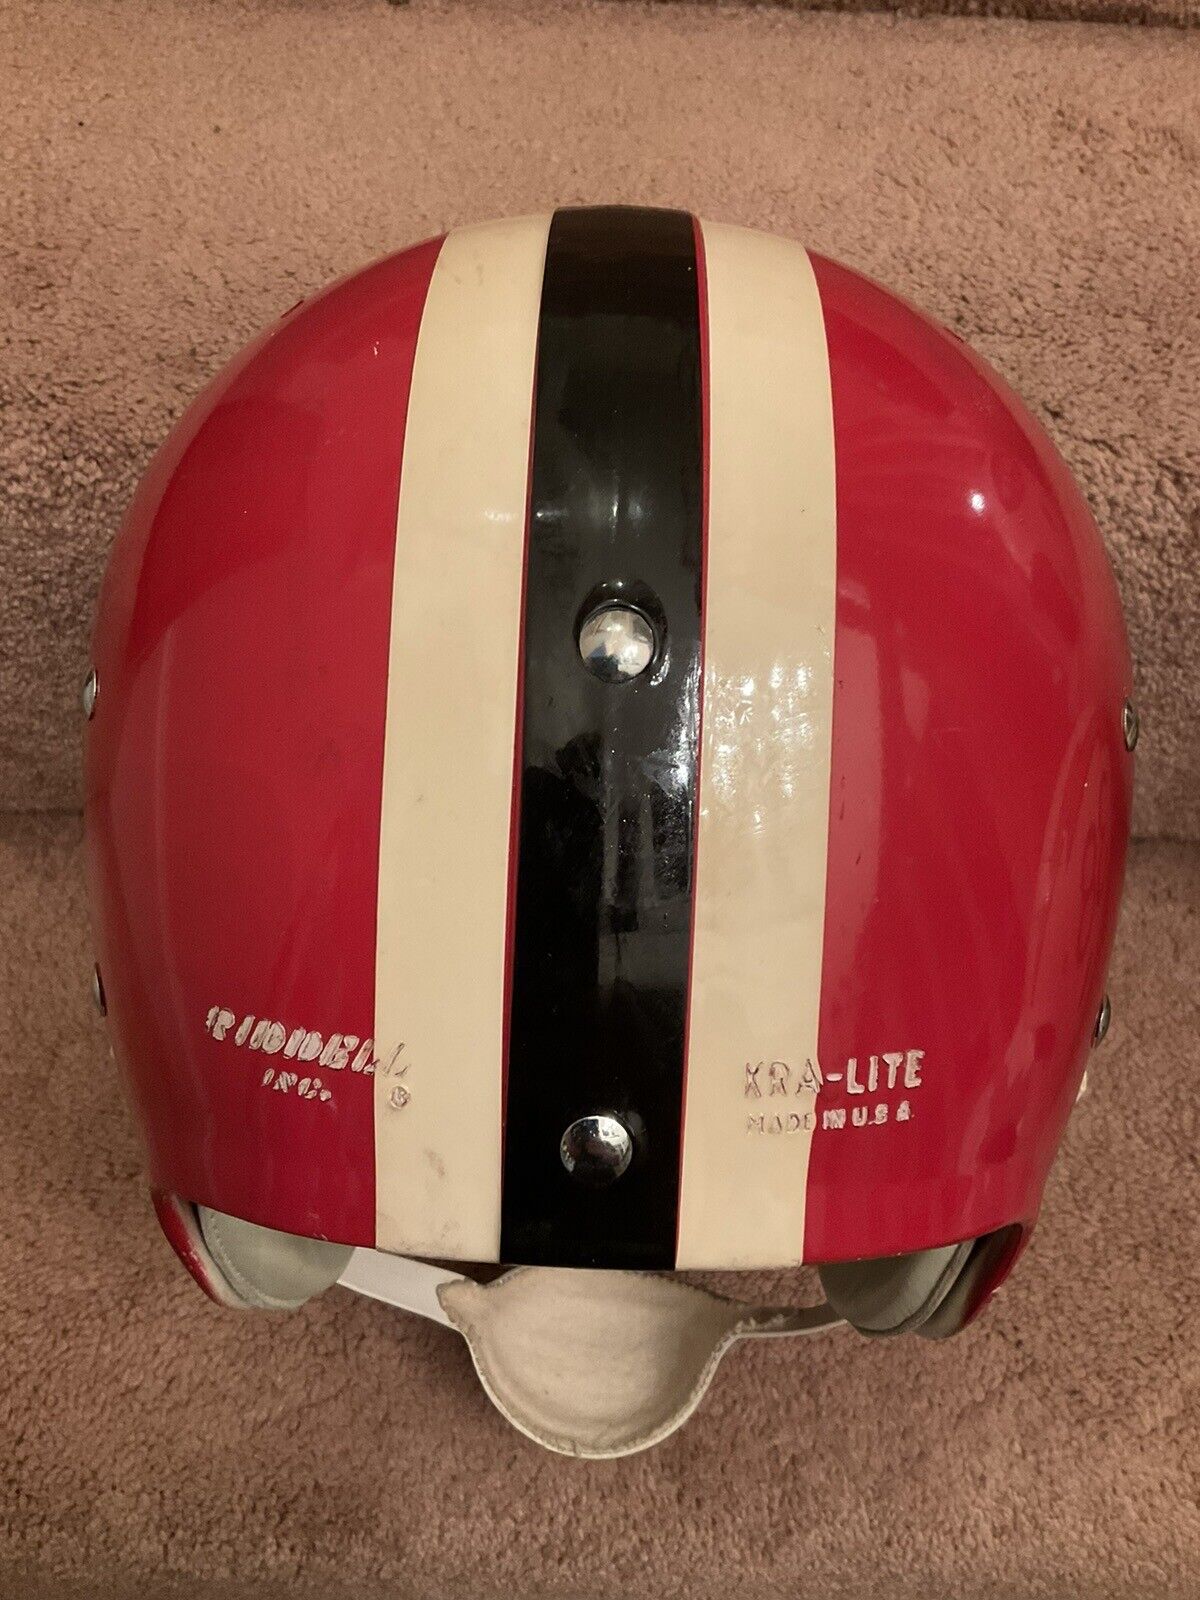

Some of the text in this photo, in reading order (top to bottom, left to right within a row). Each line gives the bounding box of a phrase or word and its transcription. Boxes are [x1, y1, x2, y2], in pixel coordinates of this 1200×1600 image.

[206, 1005, 411, 1077] RIDDELL
[744, 1050, 925, 1099] KRA-LITE
[747, 1111, 814, 1135] MADE
[822, 1108, 846, 1130] IN
